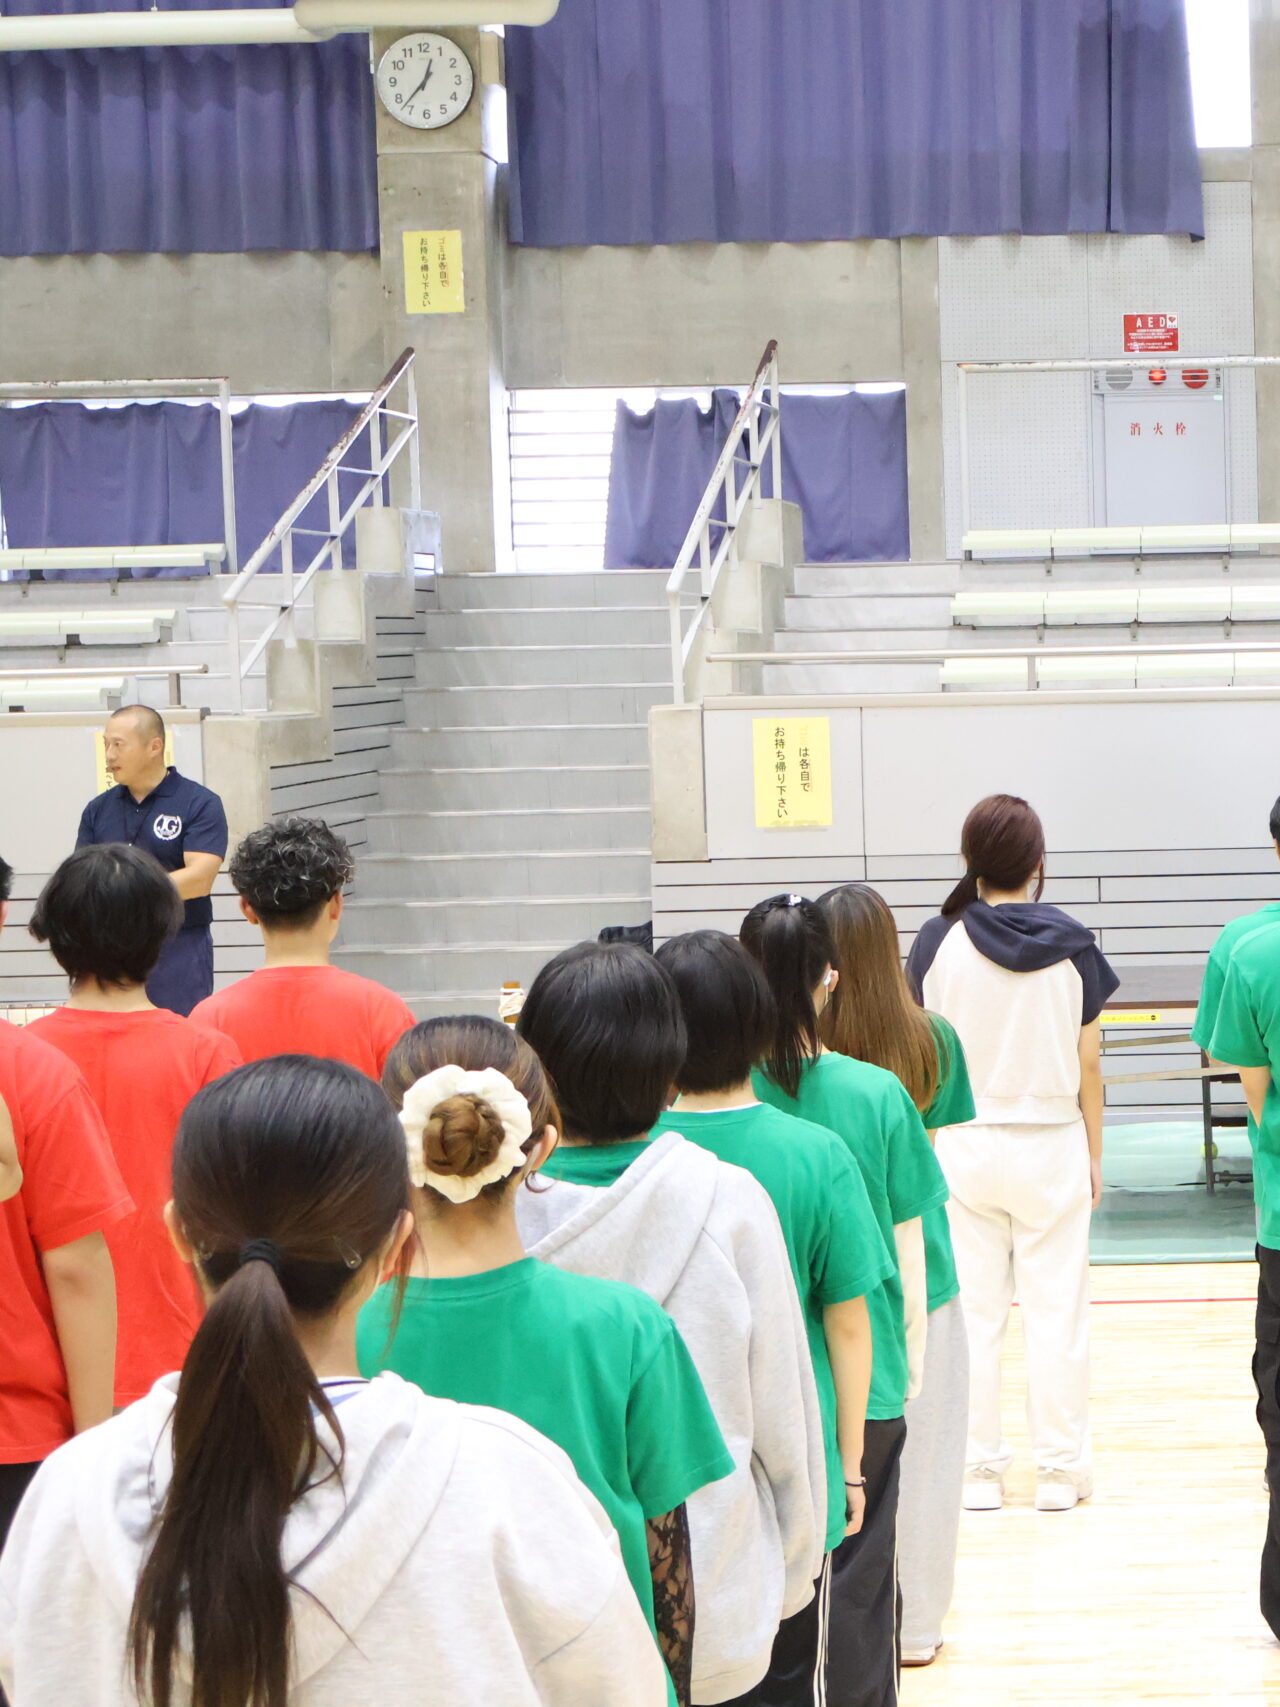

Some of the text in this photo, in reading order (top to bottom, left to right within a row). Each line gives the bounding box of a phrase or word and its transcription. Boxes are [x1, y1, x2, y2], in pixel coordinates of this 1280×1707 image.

[402, 47, 413, 58] 11
[417, 42, 430, 53] 12
[437, 46, 443, 57] 1
[392, 59, 405, 71] 10
[449, 57, 457, 68] 2
[388, 76, 397, 88] 9
[454, 74, 462, 86] 3
[394, 93, 403, 104] 8
[449, 91, 458, 102] 4
[407, 104, 415, 116] 7
[422, 108, 431, 120] 6
[439, 103, 448, 115] 5
[420, 237, 431, 307] お持ち帰り下さい
[1136, 316, 1166, 328] AED
[1130, 422, 1186, 436] 消火栓
[774, 726, 788, 818] お持ち帰り下さい
